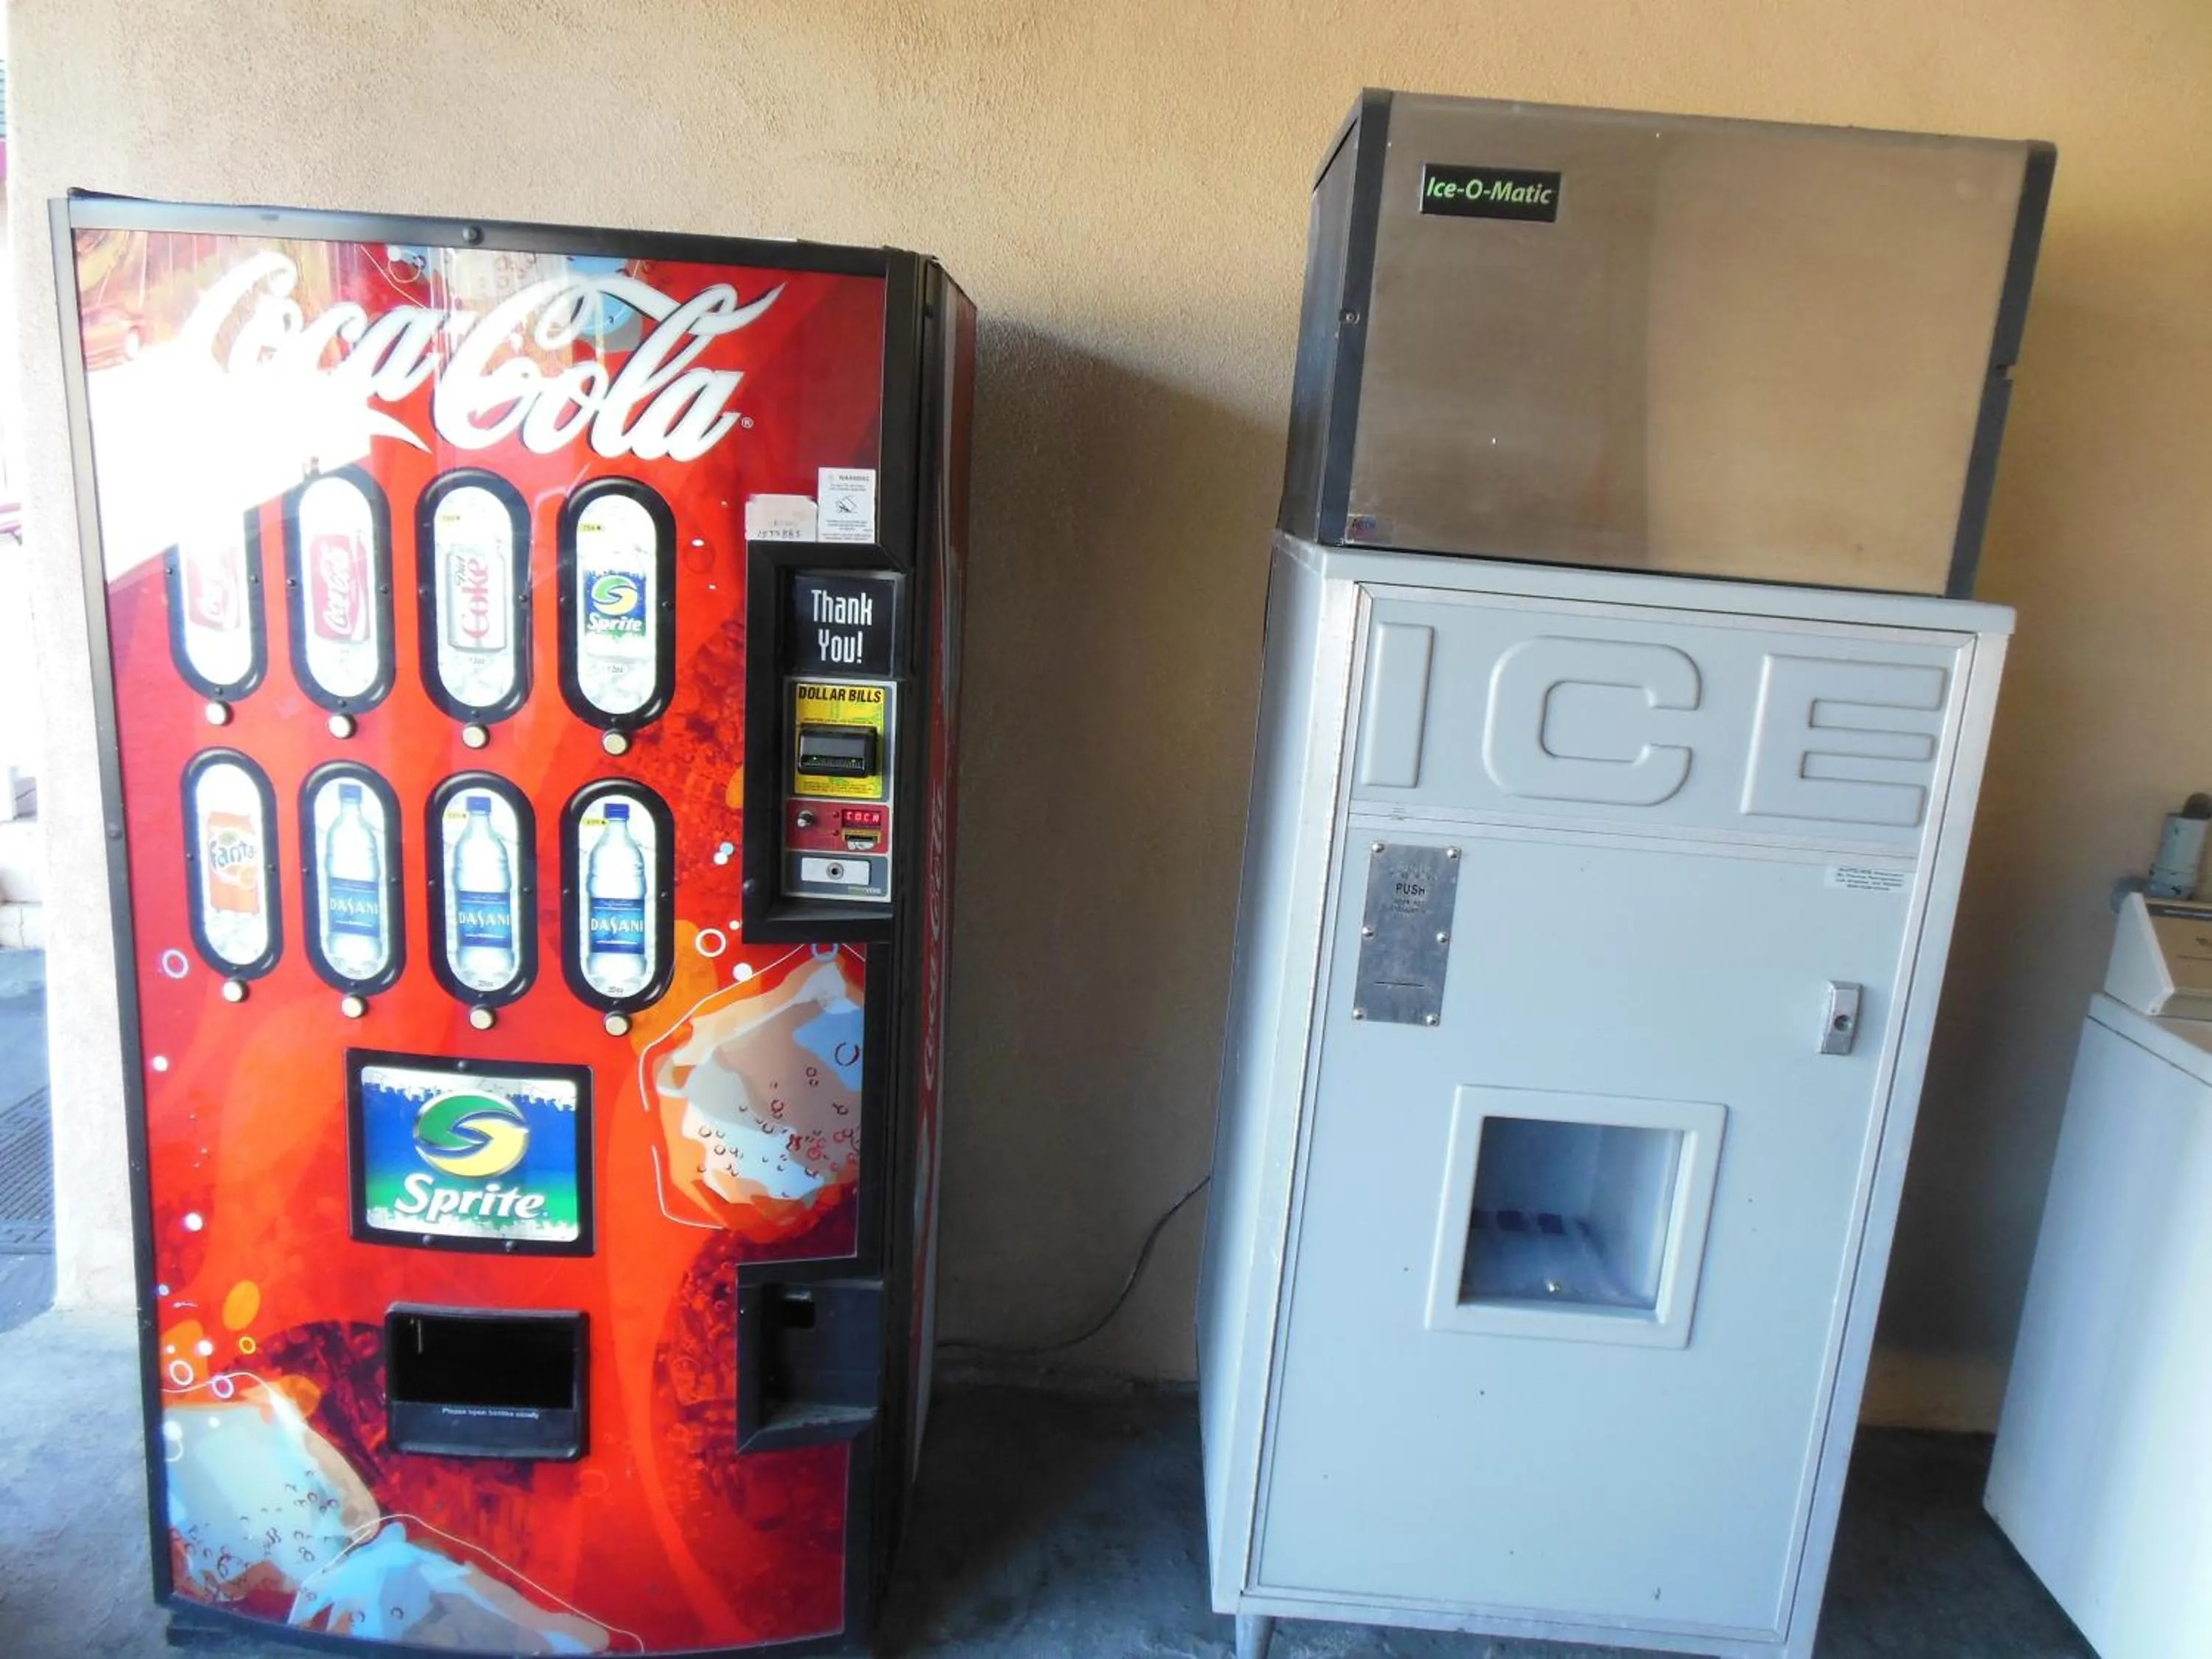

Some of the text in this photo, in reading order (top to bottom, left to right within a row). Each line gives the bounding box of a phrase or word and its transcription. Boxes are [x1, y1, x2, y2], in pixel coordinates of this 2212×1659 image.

[1426, 176, 1552, 205] Ice-O-Matic
[460, 557, 490, 639] Coke
[810, 589, 873, 626] Thank
[587, 612, 642, 632] Sprite
[818, 628, 863, 664] You!
[799, 686, 881, 703] DOLLAR BILLS
[1361, 621, 1949, 827] ICE
[1396, 883, 1425, 895] PUSH
[330, 897, 380, 916] DASANI
[458, 909, 511, 927] DASANI
[590, 917, 644, 935] DASANI
[394, 1172, 545, 1221] Sprite
